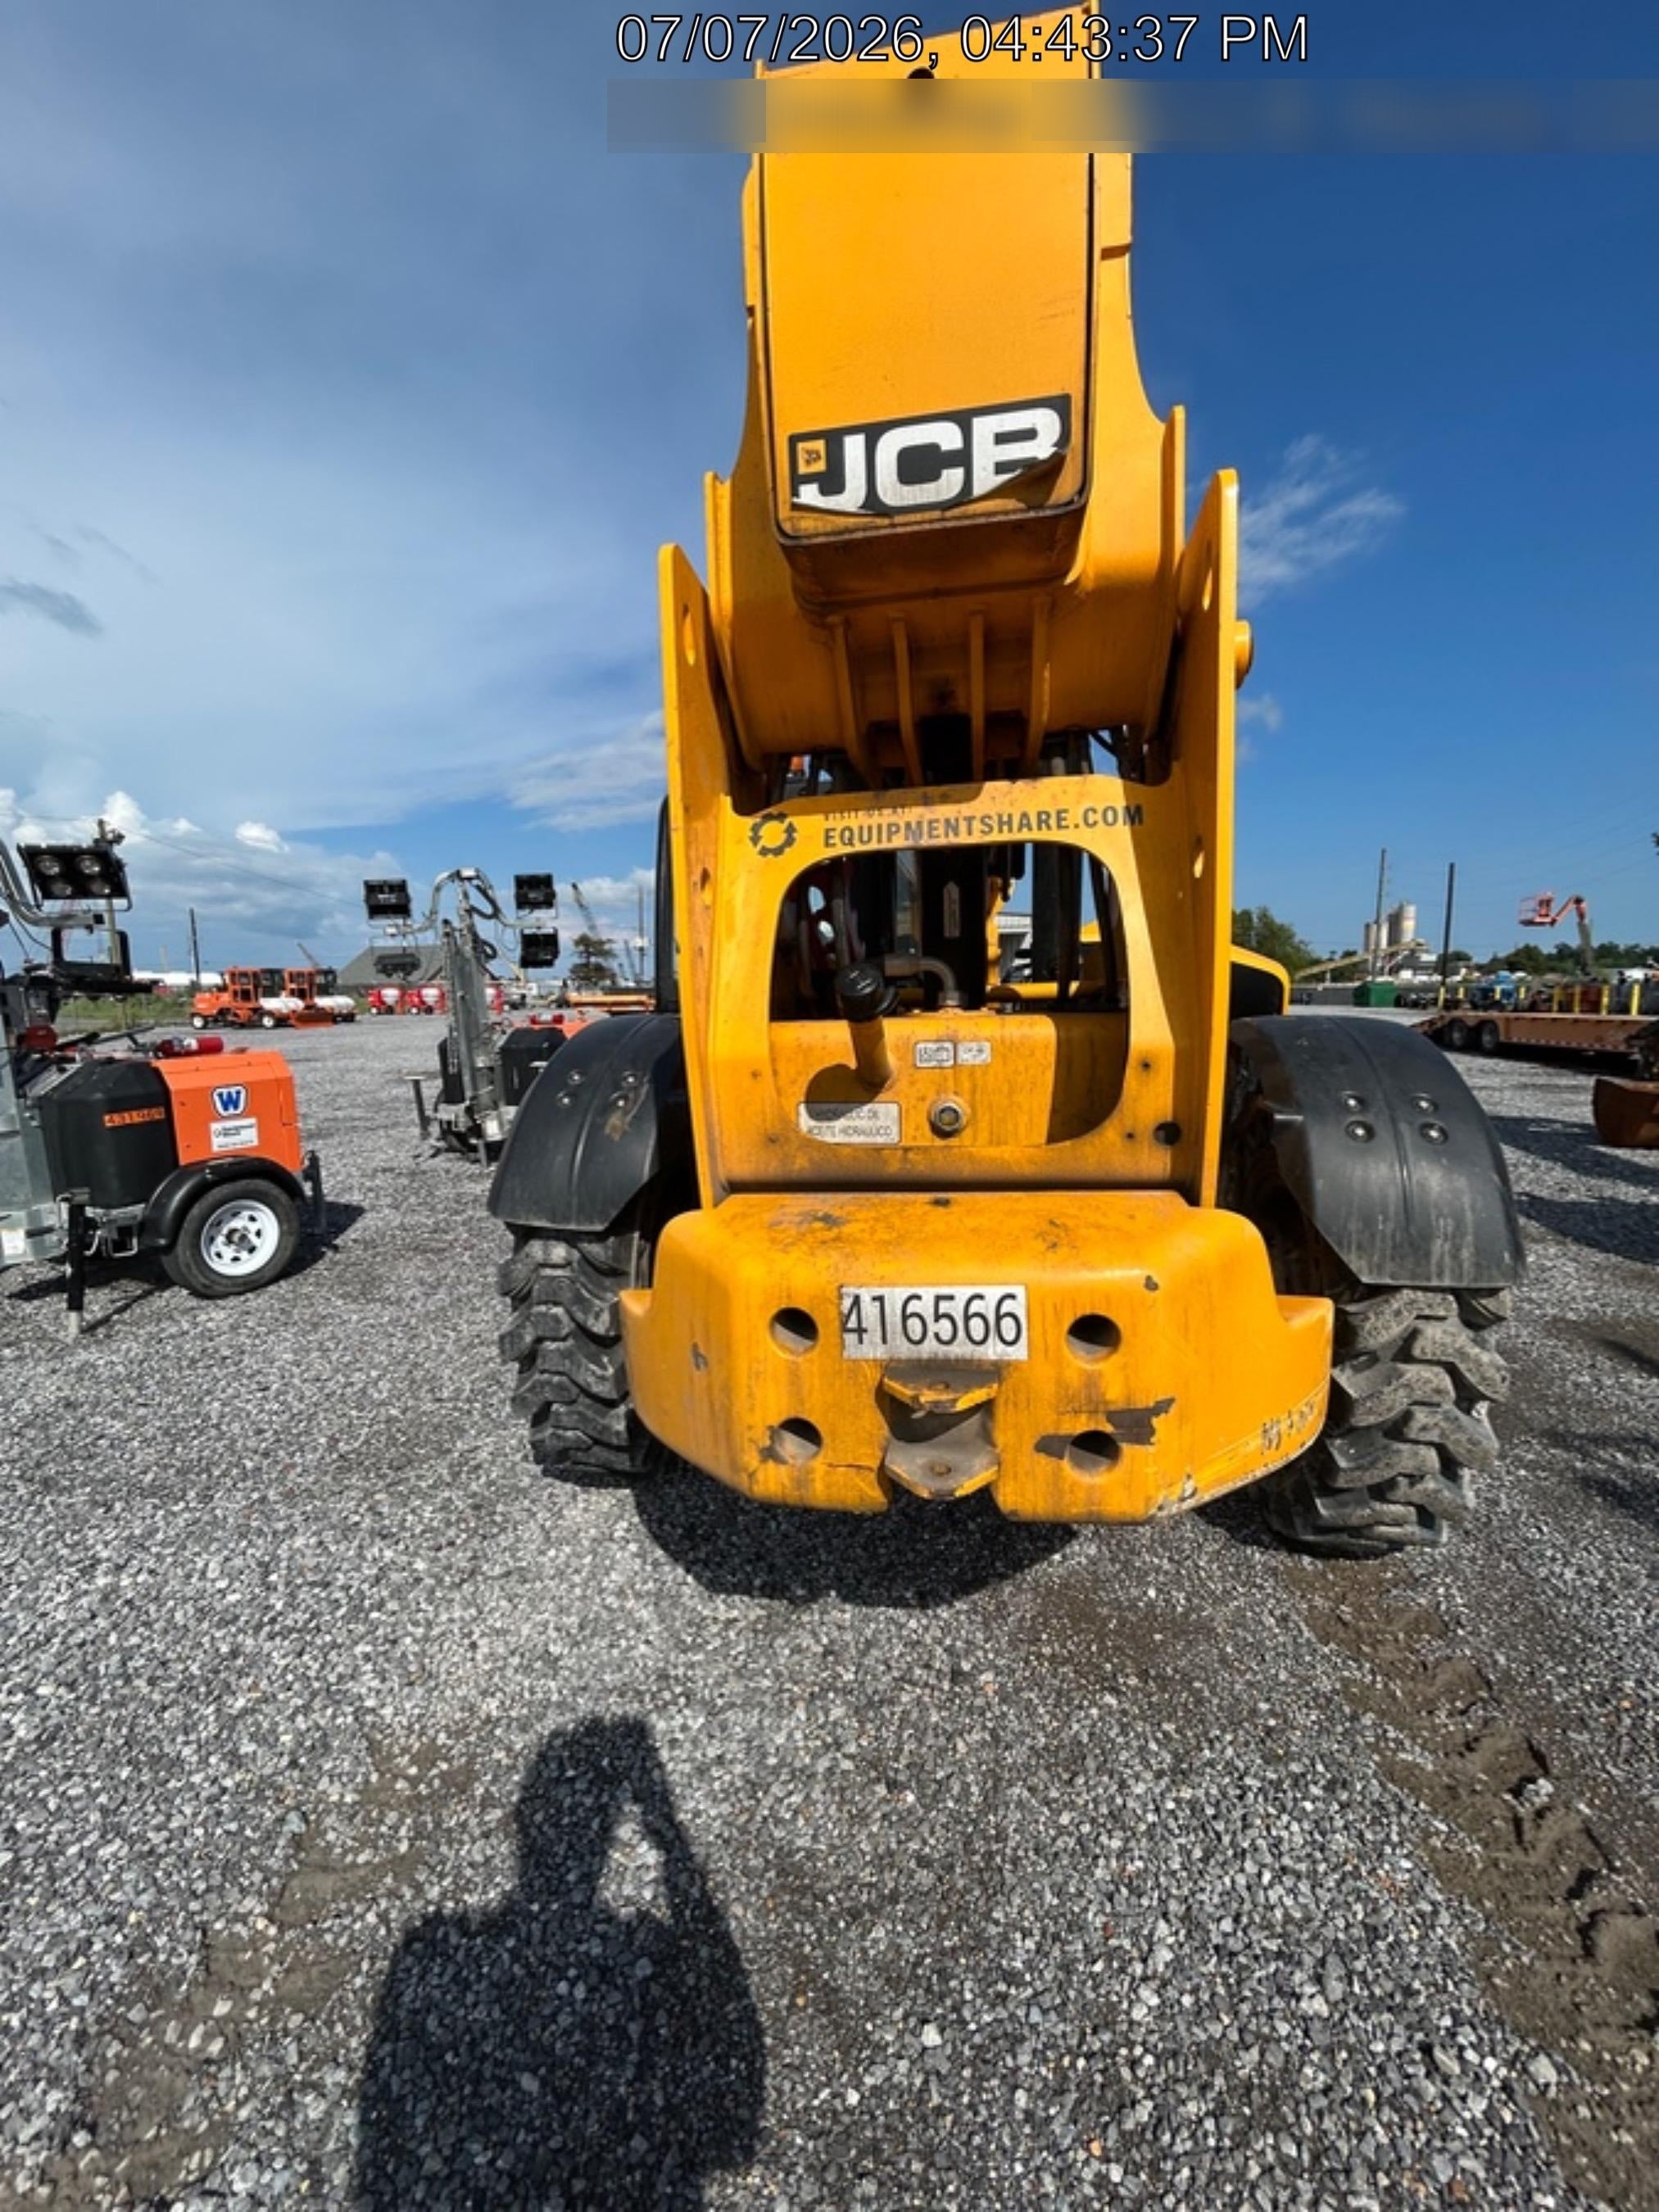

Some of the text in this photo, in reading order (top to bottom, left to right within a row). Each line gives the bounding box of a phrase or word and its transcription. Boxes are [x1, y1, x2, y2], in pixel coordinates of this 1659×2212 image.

[792, 407, 1063, 514] JCB
[823, 804, 1144, 848] EQUIPMENTSHARE.COM
[216, 1089, 243, 1112] W
[842, 1294, 1022, 1347] 416566
